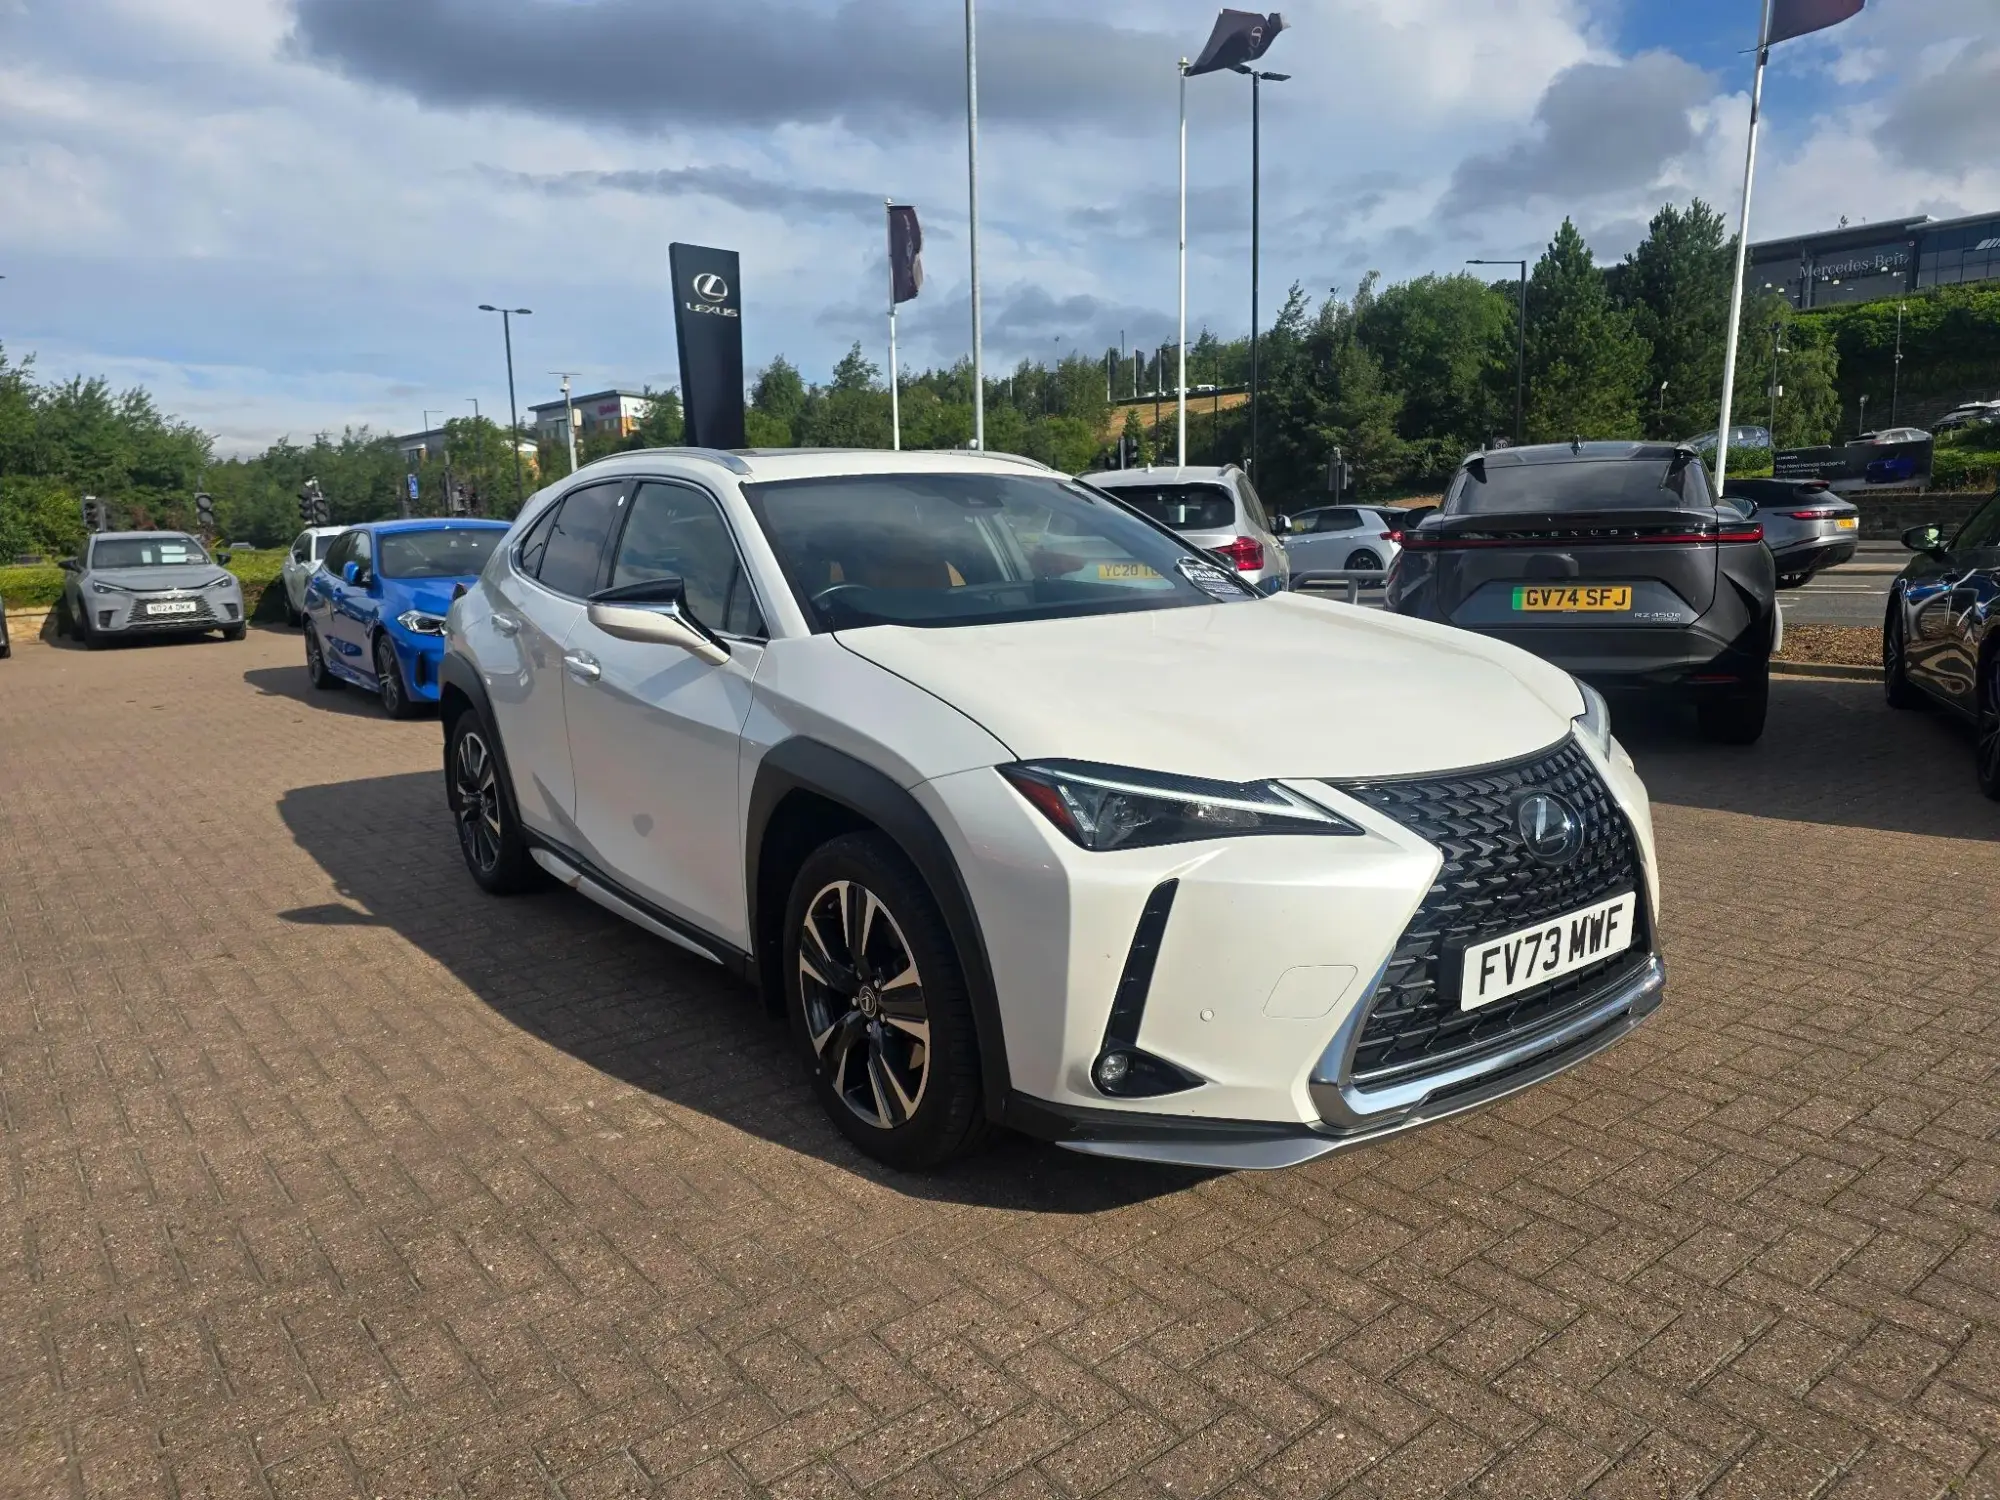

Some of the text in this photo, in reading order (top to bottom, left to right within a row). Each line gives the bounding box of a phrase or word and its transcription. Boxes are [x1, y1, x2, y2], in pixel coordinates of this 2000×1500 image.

[1800, 254, 1909, 279] Mercedes-Benz
[686, 302, 738, 317] LEXUS
[1532, 529, 1618, 537] LEXUS
[1104, 564, 1139, 577] YC20
[1526, 588, 1626, 606] GV74 SFJ
[1479, 903, 1623, 996] FV73 MWF
